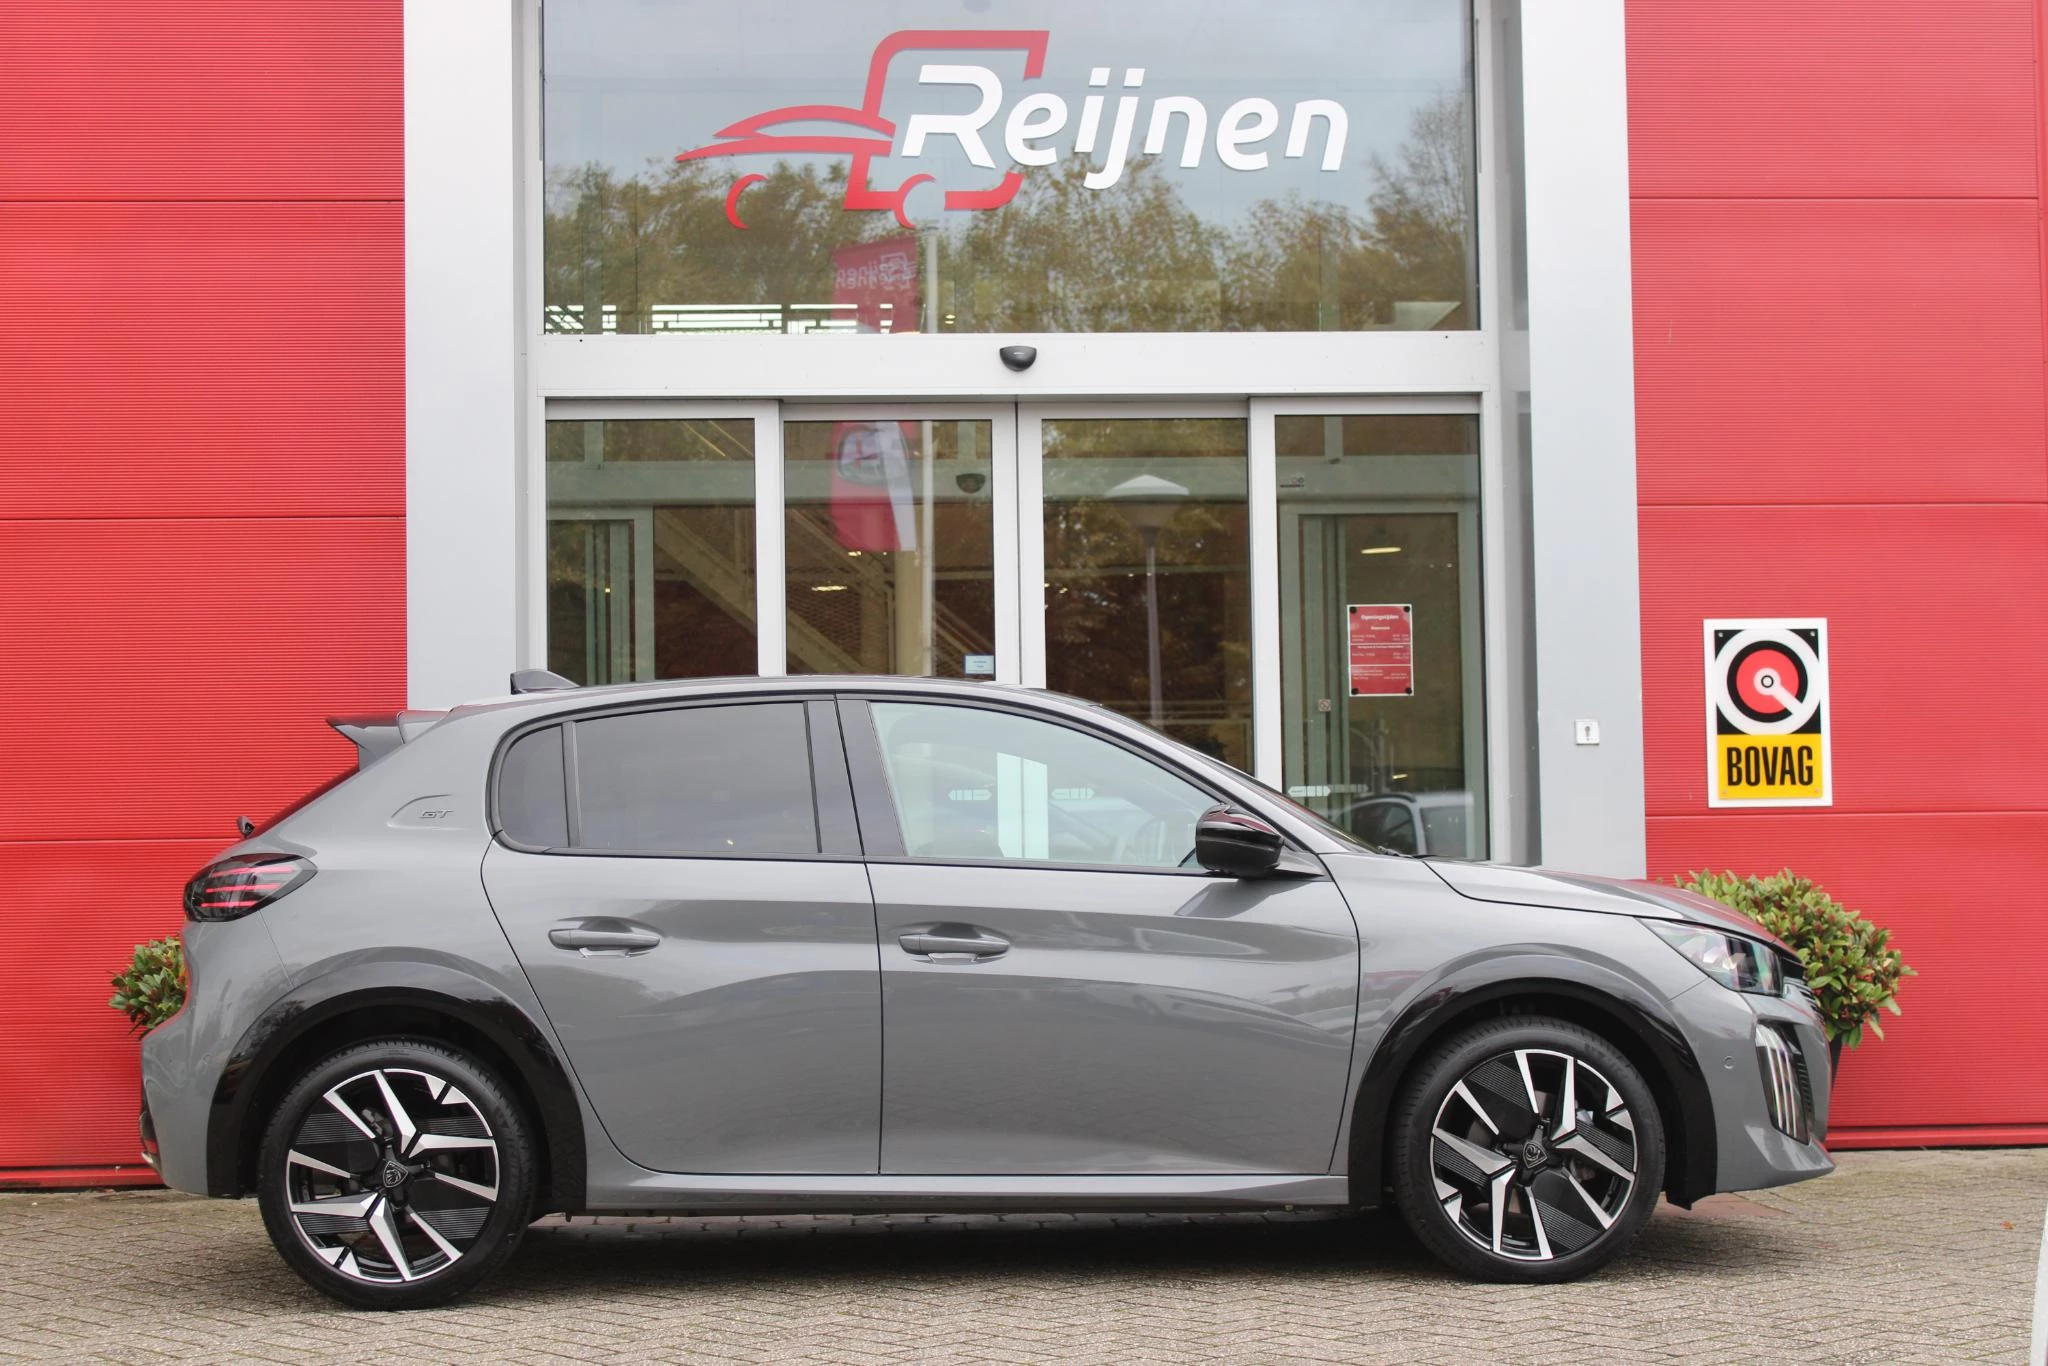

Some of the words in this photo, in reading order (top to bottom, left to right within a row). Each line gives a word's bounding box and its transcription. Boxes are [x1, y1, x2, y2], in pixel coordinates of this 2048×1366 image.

[901, 64, 1349, 190] Reijnen
[1726, 745, 1814, 787] BOVAG
[420, 809, 454, 819] GT
